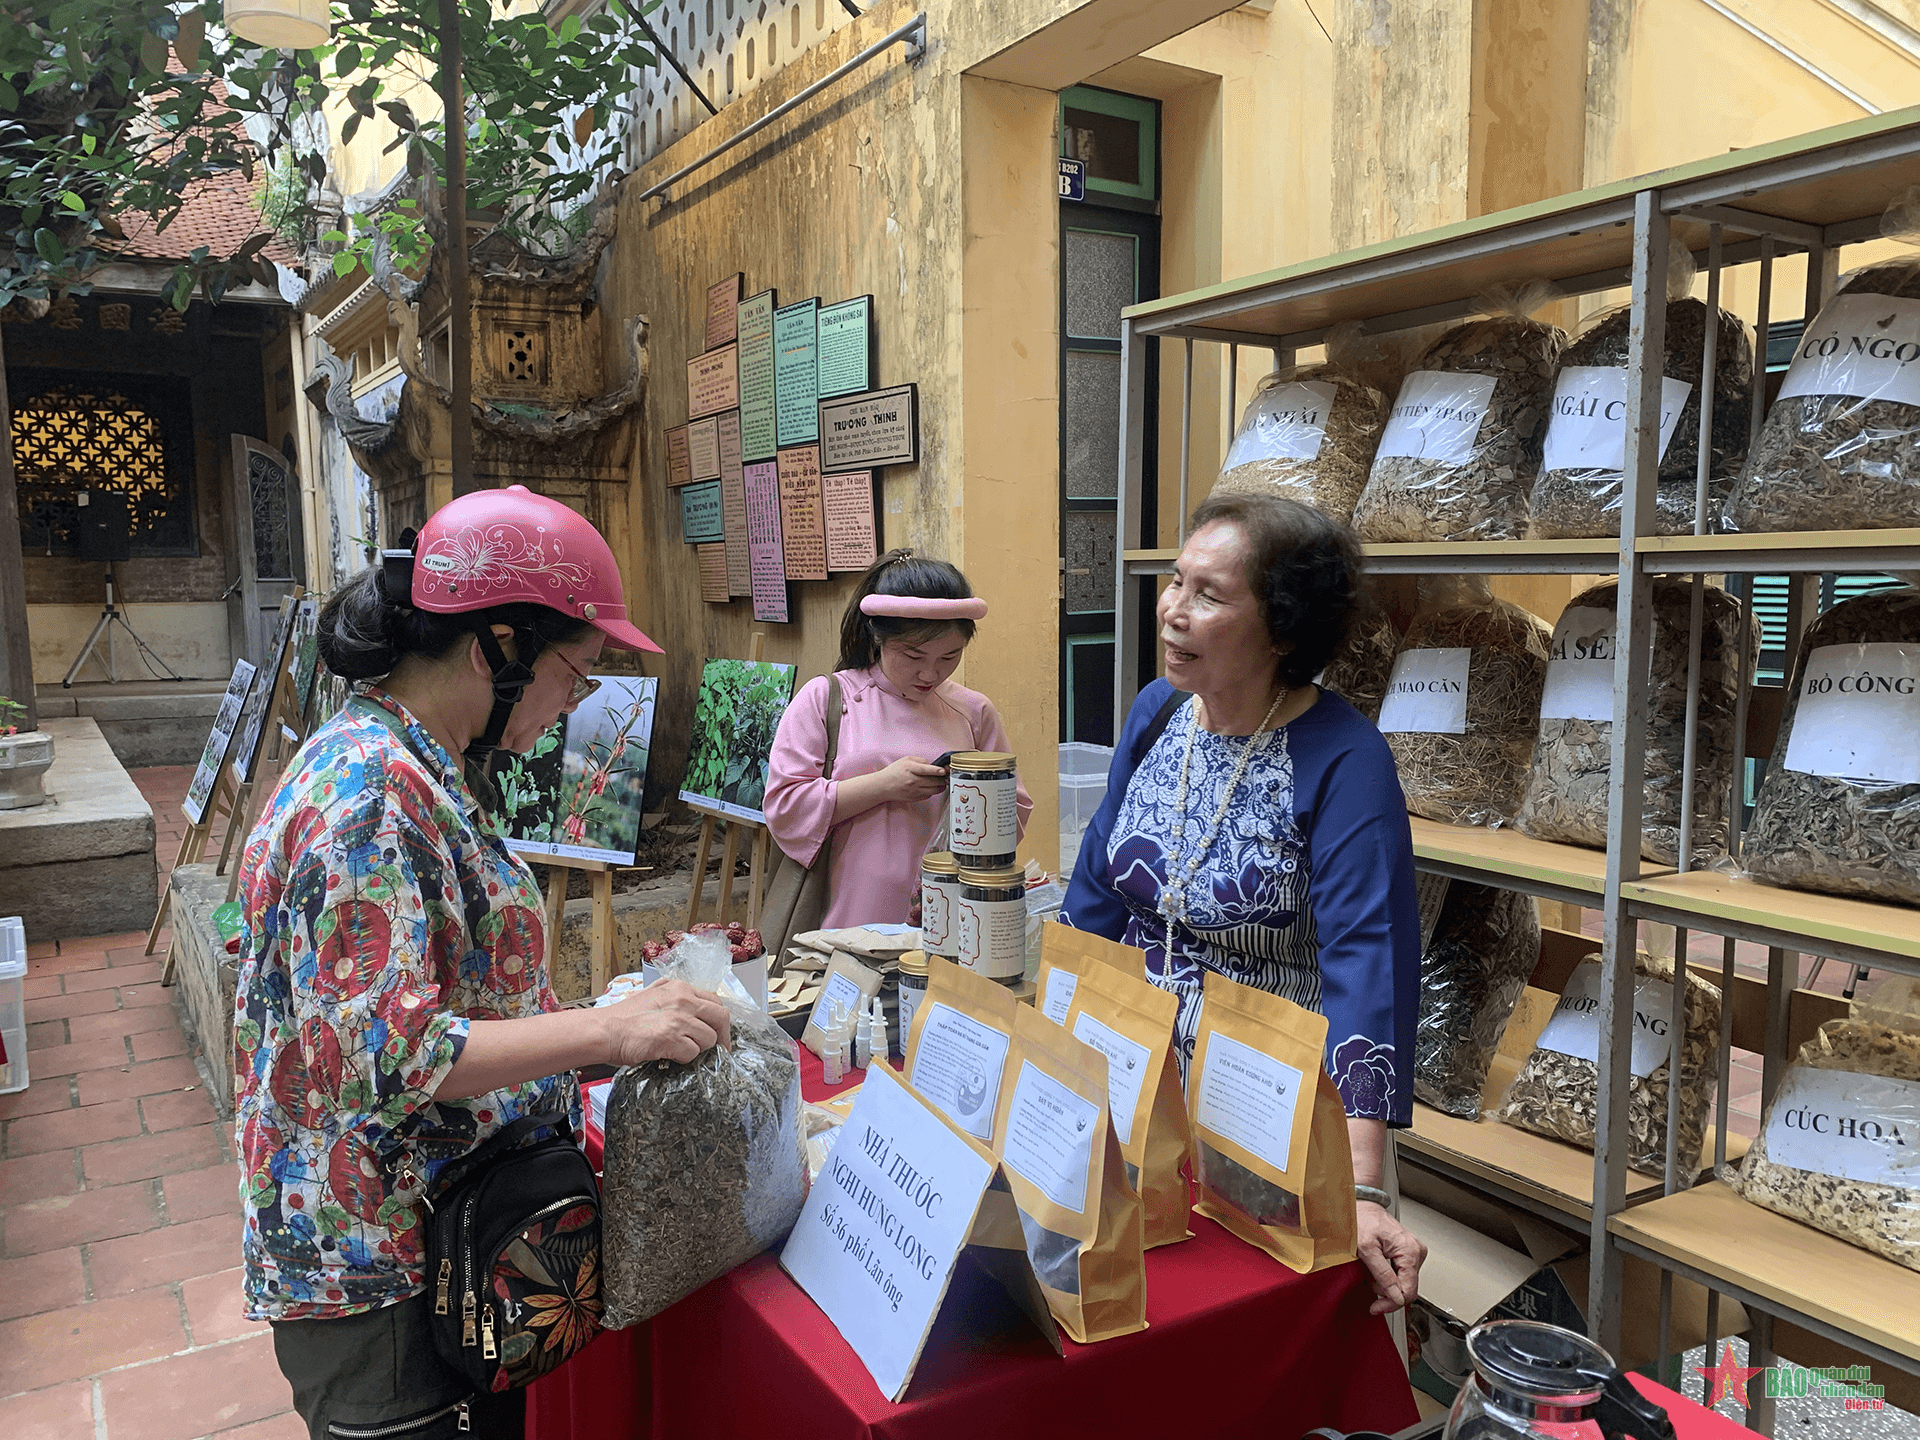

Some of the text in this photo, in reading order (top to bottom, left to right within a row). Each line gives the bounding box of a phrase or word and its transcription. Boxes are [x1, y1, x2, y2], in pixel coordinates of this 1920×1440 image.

[1803, 330, 1840, 359] CỎ
[1399, 681, 1425, 693] MAO
[1428, 678, 1461, 693] CĂN
[1838, 671, 1915, 695] CÔNG
[1785, 1105, 1906, 1146] CÚC HOA
[858, 1125, 943, 1219] NHÀ THUỐC
[828, 1155, 937, 1281] NGHI HƯNG LONG
[820, 1203, 904, 1313] Số 36 phố Lãn ông
